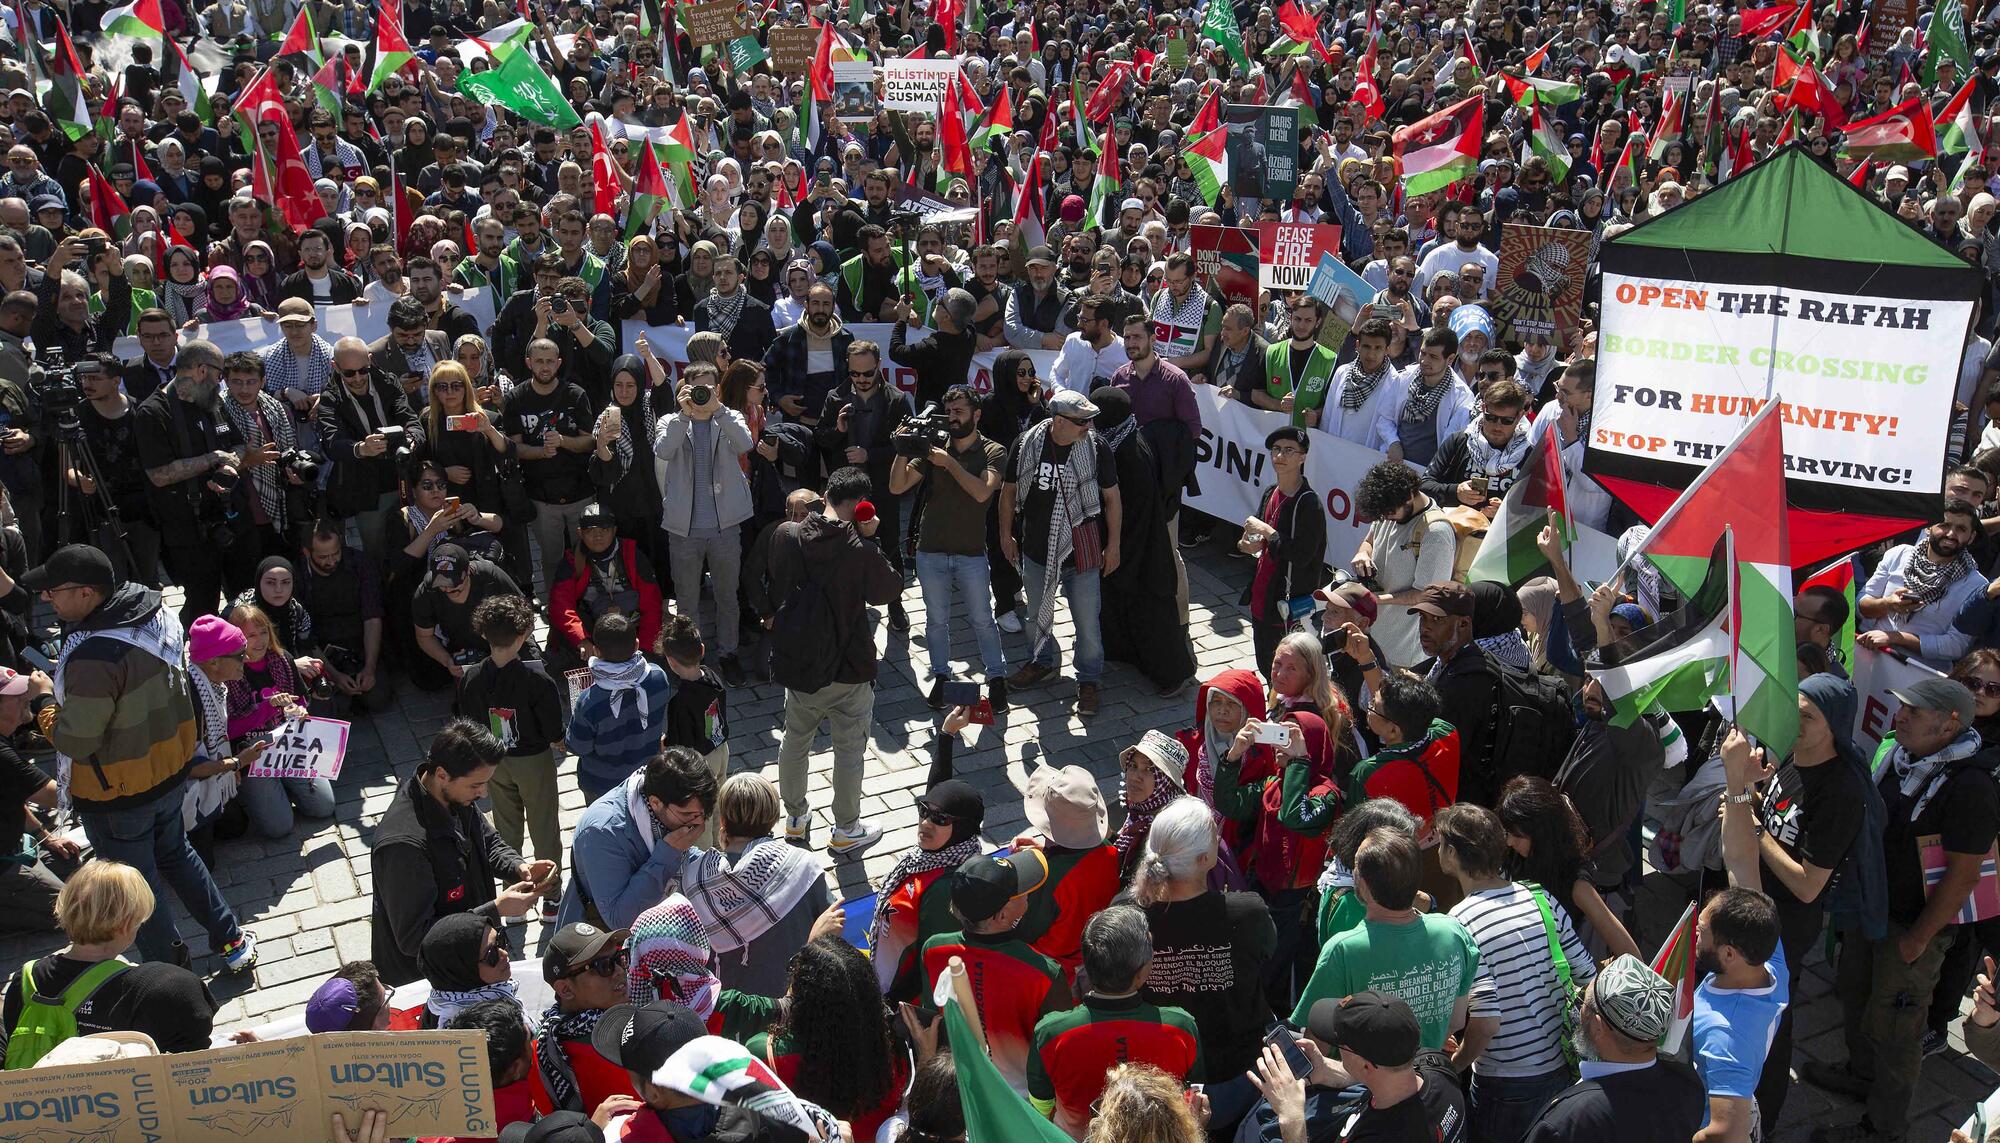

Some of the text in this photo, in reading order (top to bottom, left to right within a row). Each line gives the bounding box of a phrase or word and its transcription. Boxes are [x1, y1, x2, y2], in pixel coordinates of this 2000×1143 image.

[694, 22, 732, 35] PALESTINE
[718, 30, 734, 39] FREE
[887, 82, 946, 90] OLANLAR
[888, 92, 944, 102] SUSMAYI
[1276, 226, 1314, 244] CEASE
[1196, 250, 1221, 262] DON'T
[1272, 241, 1313, 266] FIRE
[1196, 261, 1221, 275] STOP
[1272, 266, 1310, 286] NOW!
[1616, 284, 1931, 330] OPEN THE RAFAH
[1530, 327, 1551, 335] PALESTINE
[1604, 333, 1928, 385] BORDER CROSSING
[1614, 384, 1898, 437] FOR HUMANITY!
[1596, 428, 1666, 452] STOP
[1783, 454, 1912, 485] ARVING!
[284, 719, 311, 734] ET
[276, 735, 323, 753] AZA
[263, 753, 318, 769] LIVE!
[1183, 983, 1196, 993] את
[1381, 982, 1395, 991] ARE
[1400, 974, 1432, 988] BREAKING
[1436, 970, 1448, 980] THE
[1422, 984, 1431, 993] EL
[31, 1075, 61, 1083] NATURAL
[331, 1062, 446, 1088] Sultan
[189, 1076, 297, 1105] Sultan
[458, 1046, 490, 1132] ULUDAĞ
[0, 1092, 120, 1122] Sultan
[131, 1074, 162, 1143] ULUDA
